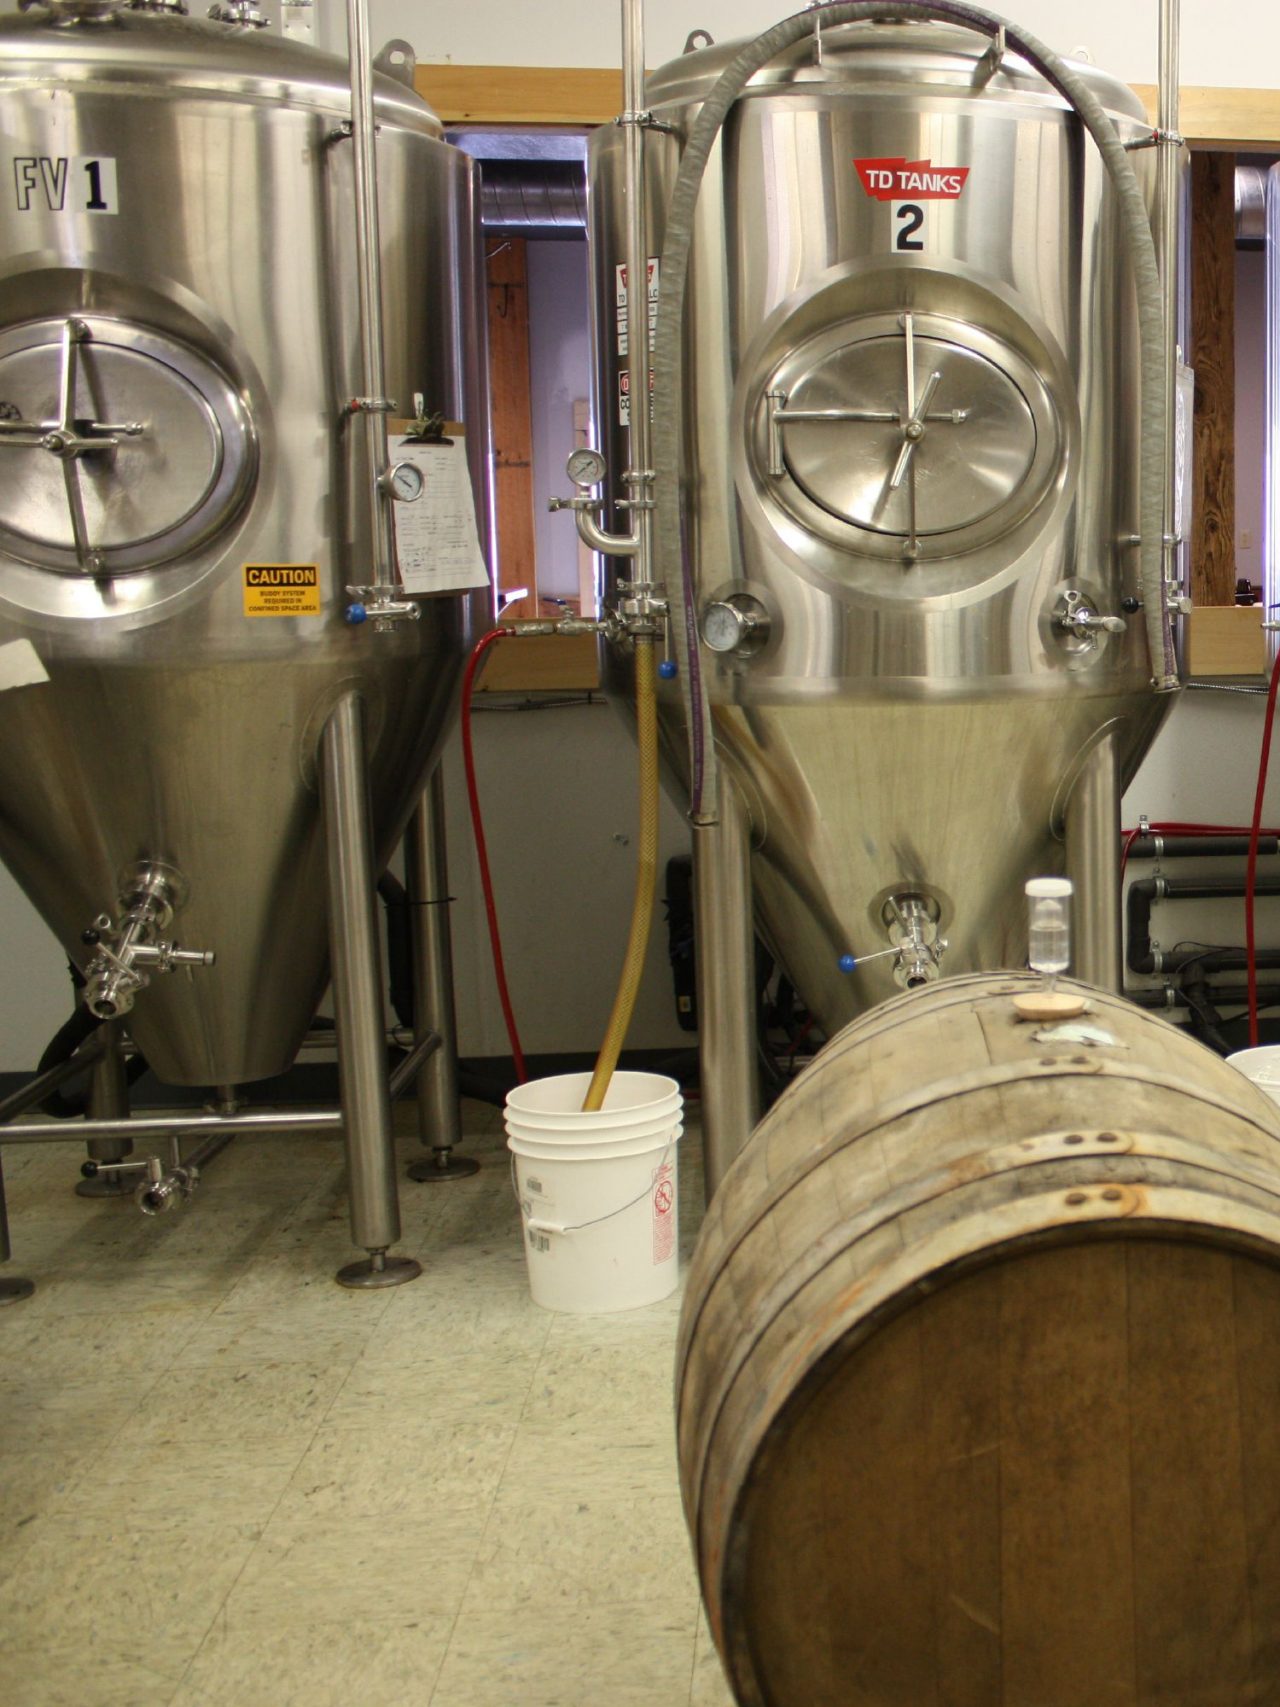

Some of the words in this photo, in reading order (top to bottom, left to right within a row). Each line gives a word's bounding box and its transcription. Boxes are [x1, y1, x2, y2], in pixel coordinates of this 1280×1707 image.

[13, 157, 68, 210] FV
[84, 160, 107, 209] 1
[865, 169, 893, 189] TD
[897, 171, 961, 194] TANKS
[896, 203, 924, 251] 2
[249, 569, 315, 584] CAUTION
